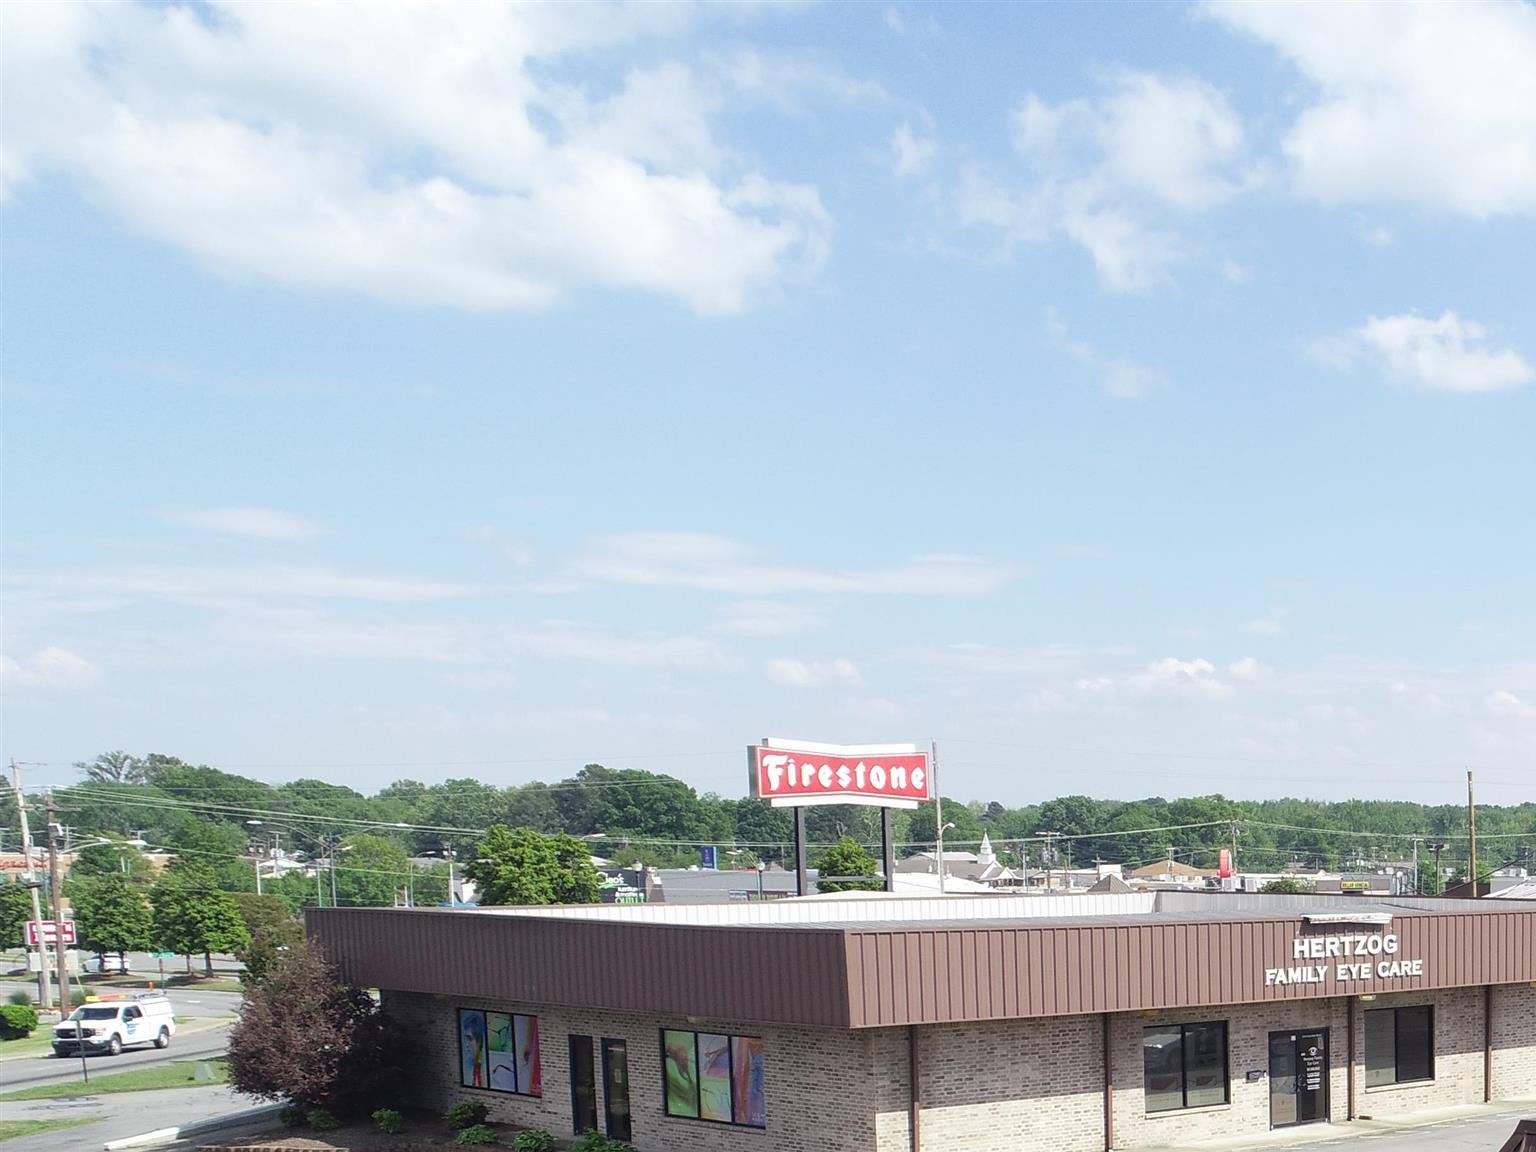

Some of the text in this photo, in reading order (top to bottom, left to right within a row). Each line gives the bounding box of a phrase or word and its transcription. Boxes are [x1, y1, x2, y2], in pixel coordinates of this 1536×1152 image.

[762, 755, 925, 791] Firestone
[1293, 934, 1398, 959] HERTZOG
[1265, 960, 1423, 986] FAMILY EYE CARE
